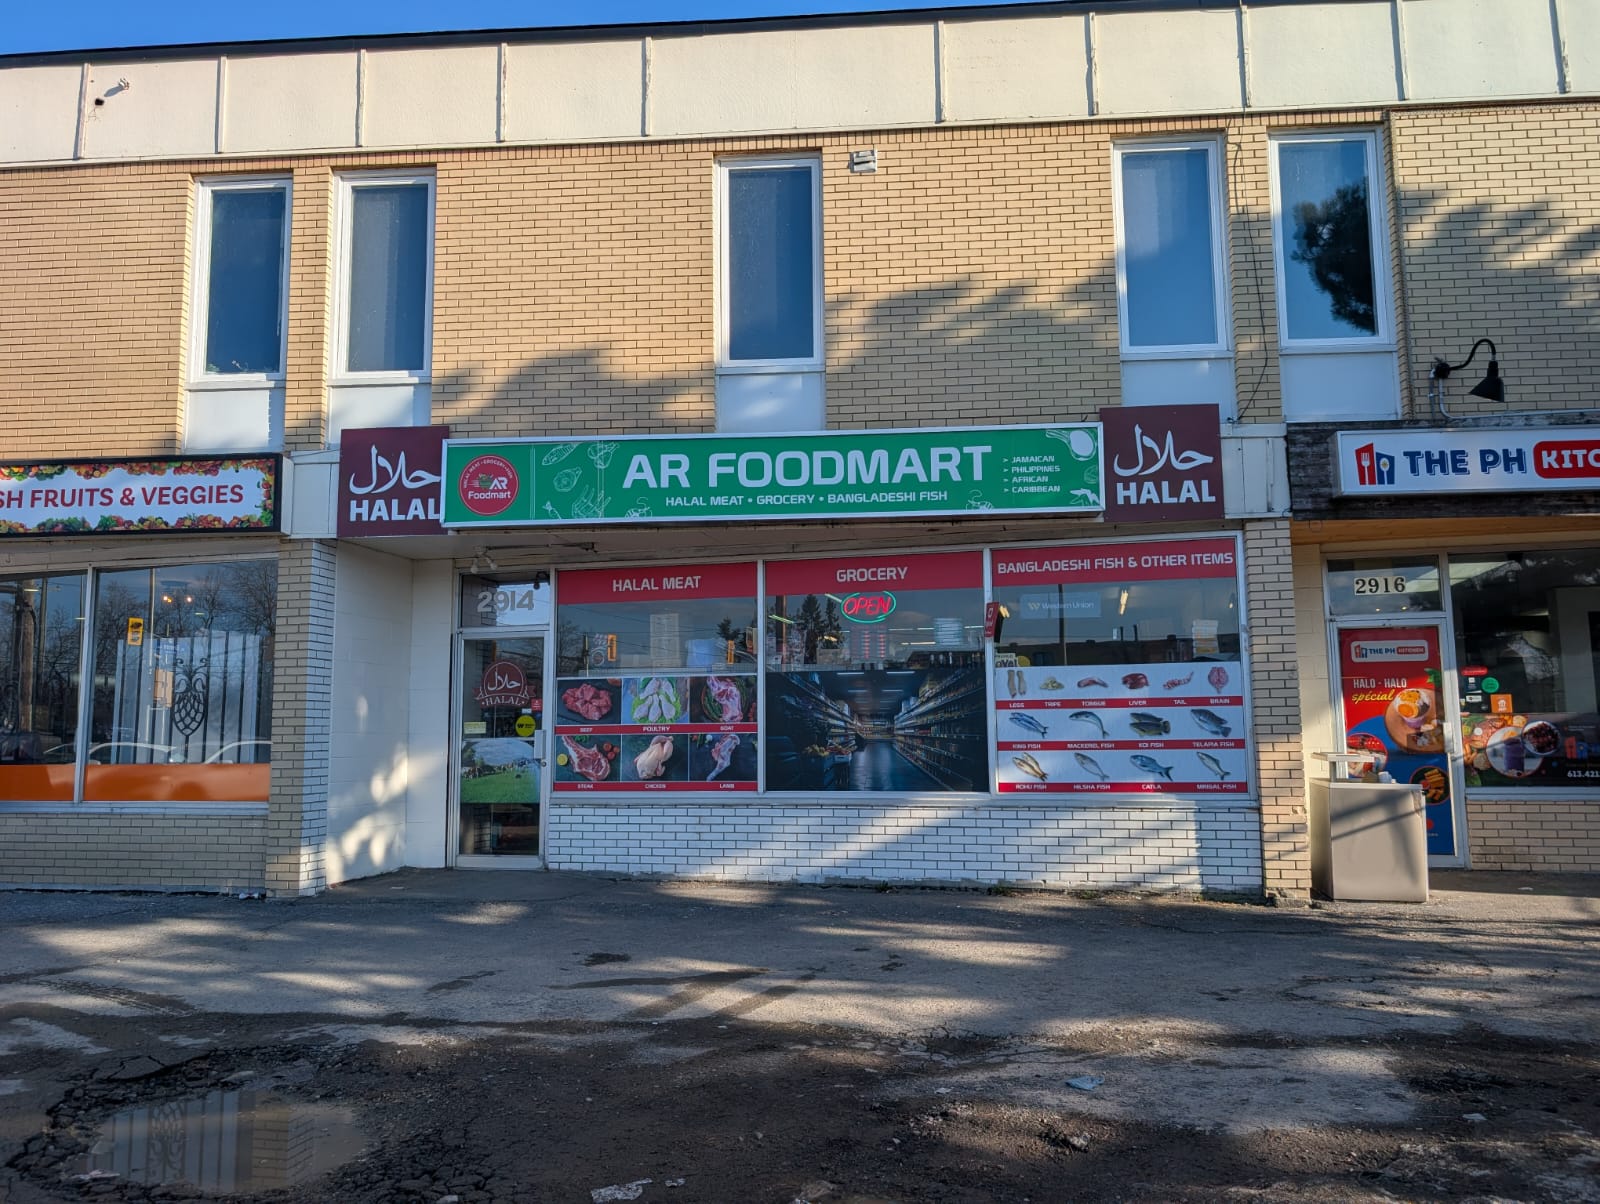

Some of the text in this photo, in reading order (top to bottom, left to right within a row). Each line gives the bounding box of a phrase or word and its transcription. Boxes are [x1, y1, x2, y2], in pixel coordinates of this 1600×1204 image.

[1113, 423, 1214, 477] حلال
[622, 445, 992, 489] AR FOODMART
[1012, 455, 1055, 463] JAMAICAN
[1403, 449, 1470, 477] THE
[1479, 448, 1527, 475] PH
[349, 444, 440, 495] حلال
[1012, 465, 1061, 473] PHILIPPINES
[489, 476, 508, 490] AR
[1012, 475, 1049, 483] AFRICAN
[30, 487, 114, 508] FRUITS
[120, 487, 135, 506] &
[141, 484, 244, 506] VEGGIES
[468, 491, 511, 499] Foodmart
[1012, 485, 1061, 493] CARIBBEAN
[1116, 479, 1216, 505] HALAL
[665, 490, 948, 507] HALAL MEAT GROCERY BANGLADESHI FISH
[350, 498, 440, 522] HALAL
[997, 552, 1233, 575] BANGLADESHI FISH & OTHER ITEMS
[836, 566, 908, 583] GROCERY
[612, 575, 702, 592] HALAL MEAT
[1355, 576, 1406, 594] 2916
[477, 589, 535, 613] 2914
[843, 595, 891, 616] OPEN
[1369, 647, 1384, 655] THE
[487, 671, 521, 691] حلال
[1353, 678, 1376, 689] HALO
[1384, 677, 1407, 688] HALO
[485, 695, 522, 706] HALAL
[1220, 740, 1235, 748] FISH
